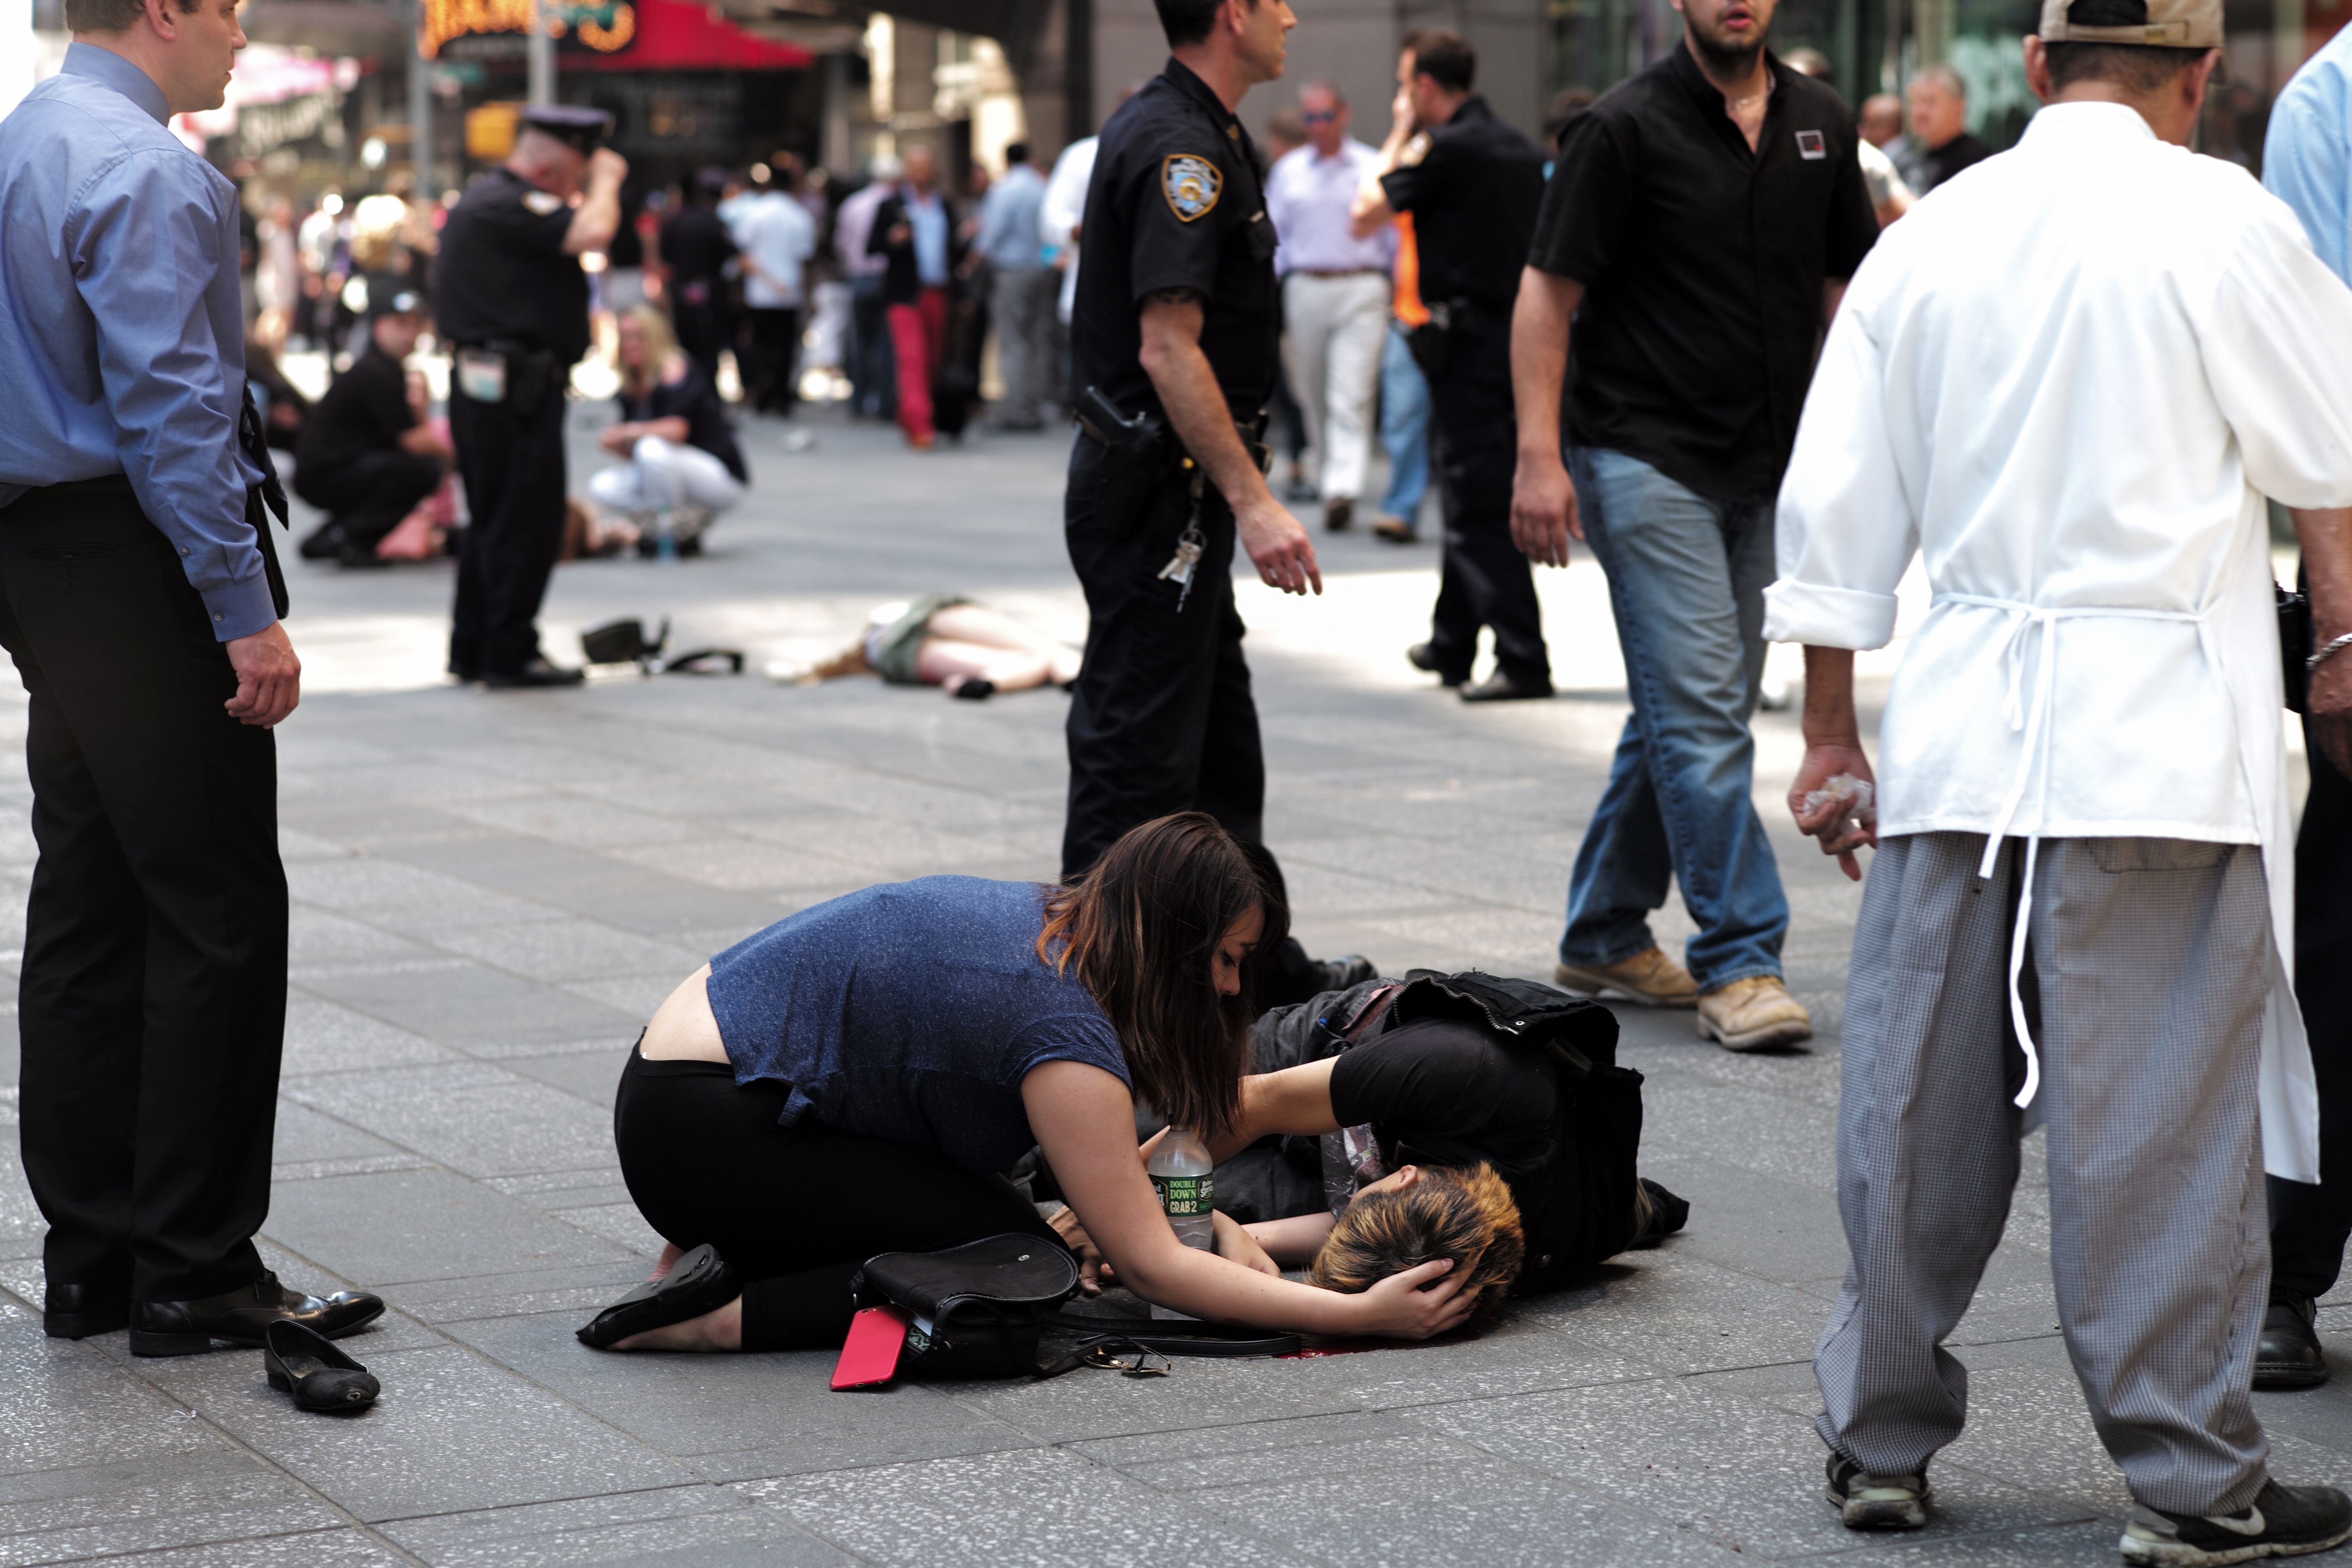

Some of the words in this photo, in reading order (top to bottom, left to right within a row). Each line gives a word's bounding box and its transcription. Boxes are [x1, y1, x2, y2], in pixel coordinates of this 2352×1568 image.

[1170, 1189, 1197, 1199] DOWN
[1170, 1201, 1191, 1213] GRAB
[1191, 1201, 1197, 1212] 2
